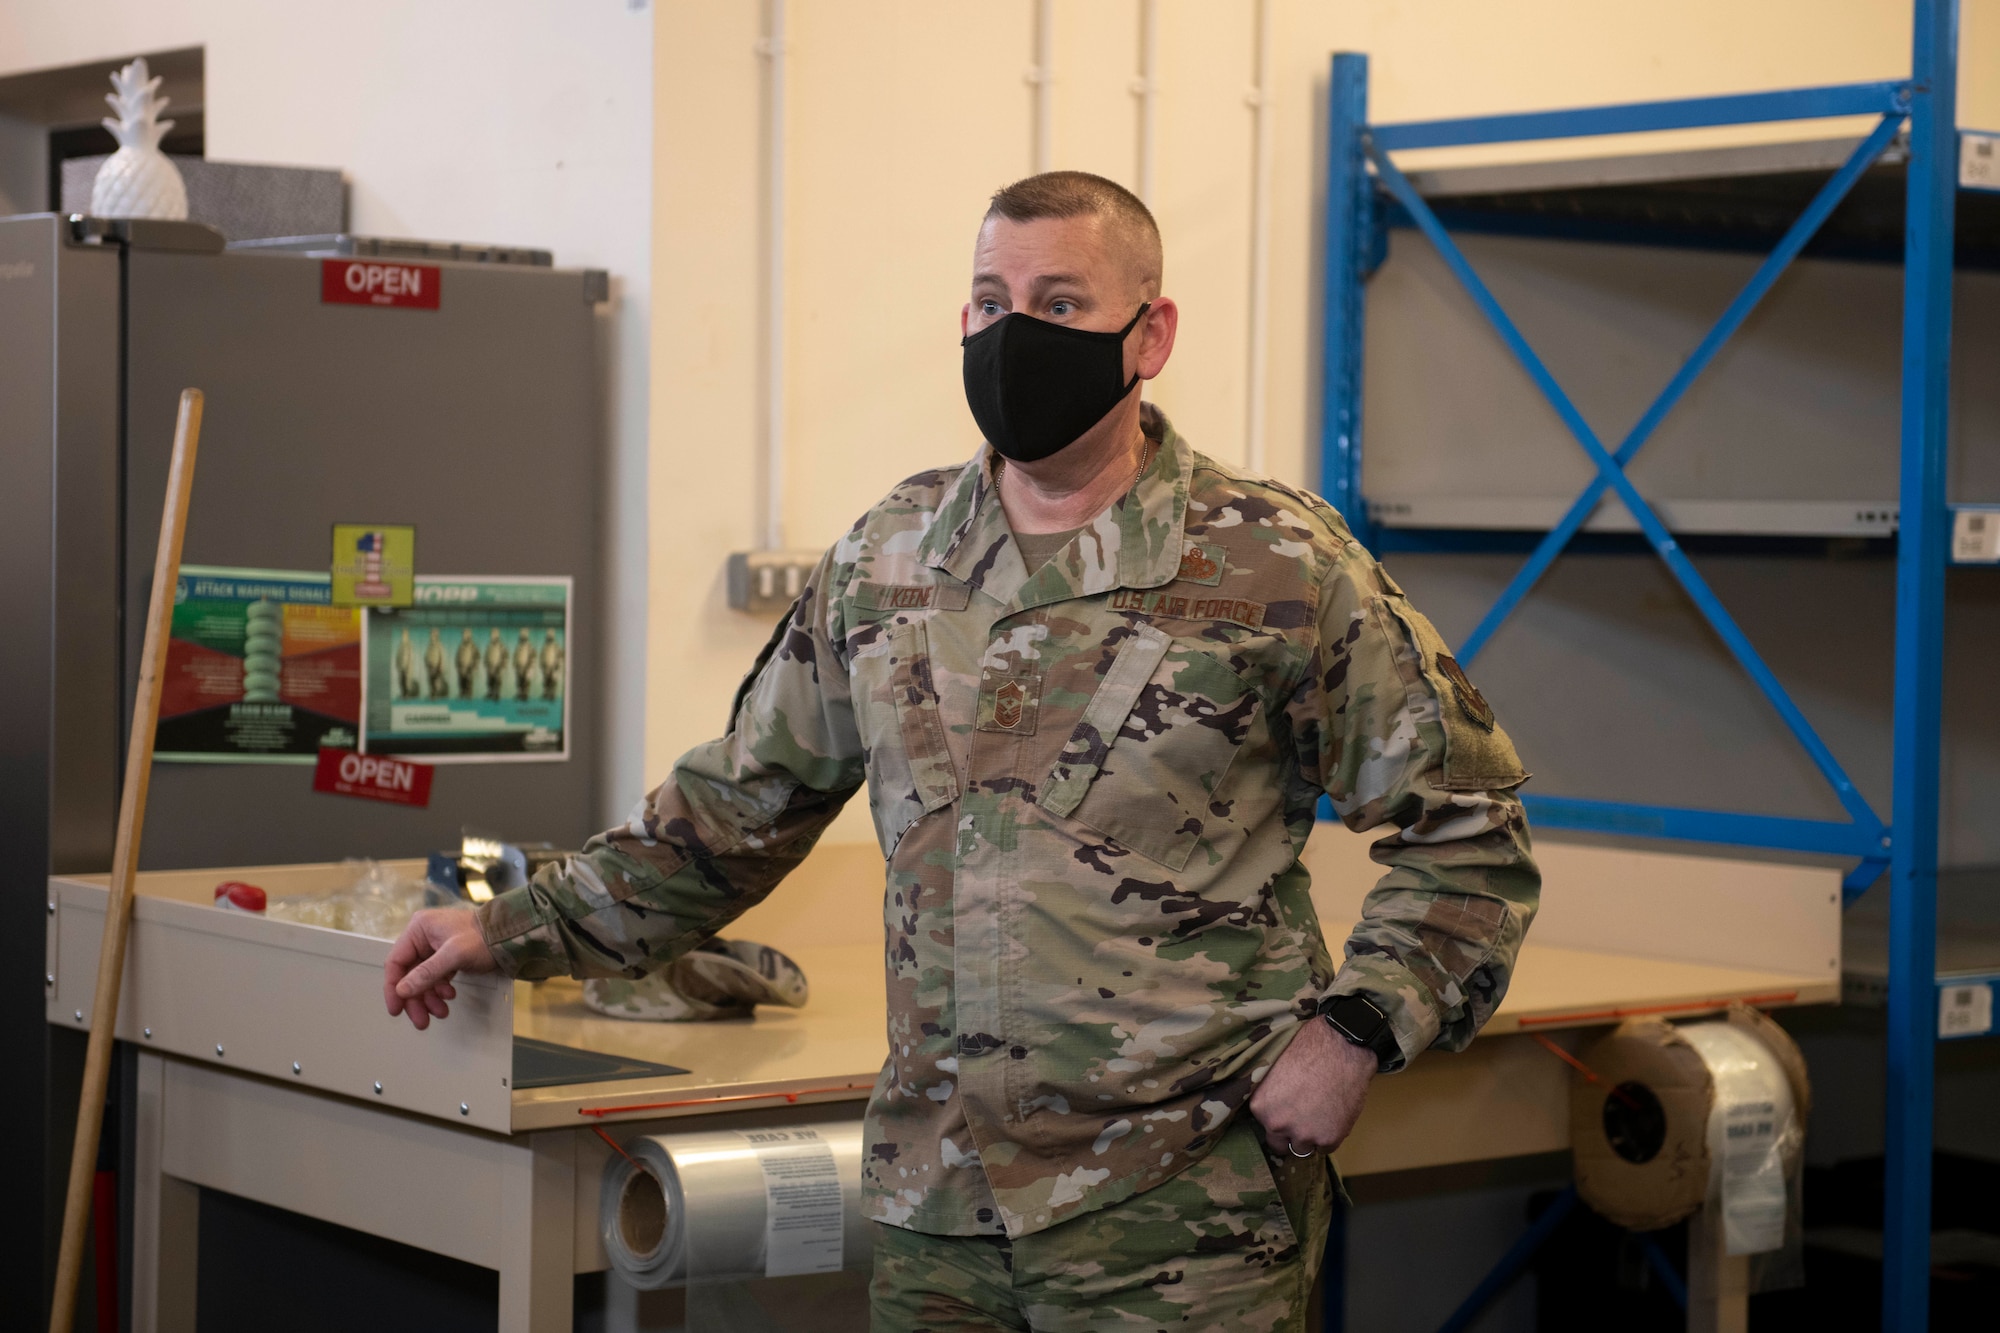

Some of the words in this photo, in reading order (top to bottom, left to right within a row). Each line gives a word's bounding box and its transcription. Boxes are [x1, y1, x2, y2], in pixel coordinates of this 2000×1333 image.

[345, 263, 421, 297] OPEN
[194, 581, 234, 597] ATTACK
[236, 585, 285, 599] WARNING
[890, 586, 934, 607] KEENE
[1112, 590, 1146, 611] U.S.
[1153, 594, 1187, 616] AIR
[1194, 599, 1263, 627] FORCE
[339, 754, 414, 791] OPEN
